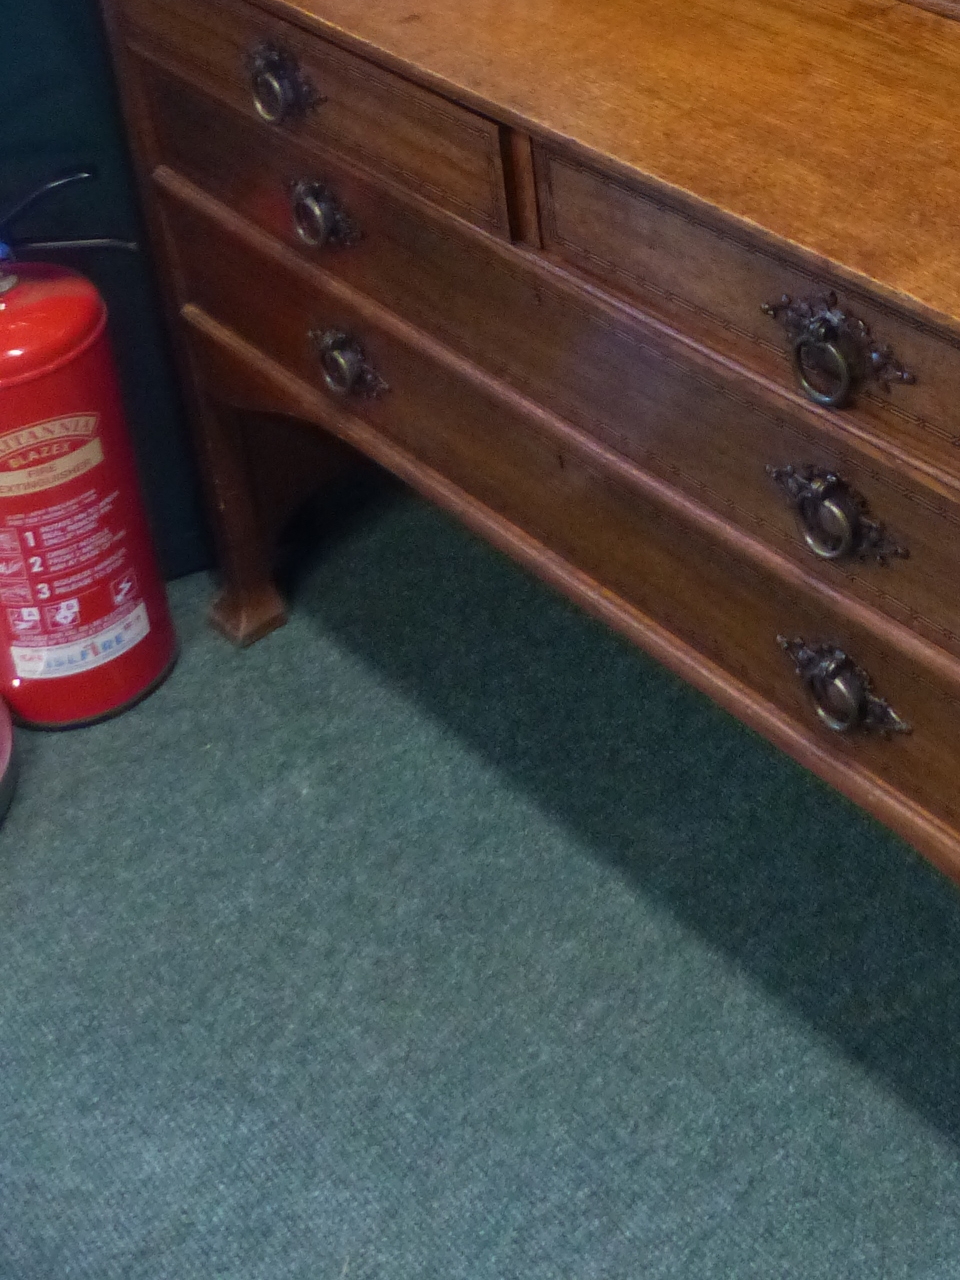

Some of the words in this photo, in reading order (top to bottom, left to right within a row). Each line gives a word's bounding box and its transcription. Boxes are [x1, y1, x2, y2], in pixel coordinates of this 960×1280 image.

[10, 441, 71, 468] BLAZEX
[28, 464, 57, 479] FIRE
[24, 531, 36, 548] 1
[29, 556, 44, 573] 2
[36, 582, 52, 599] 3
